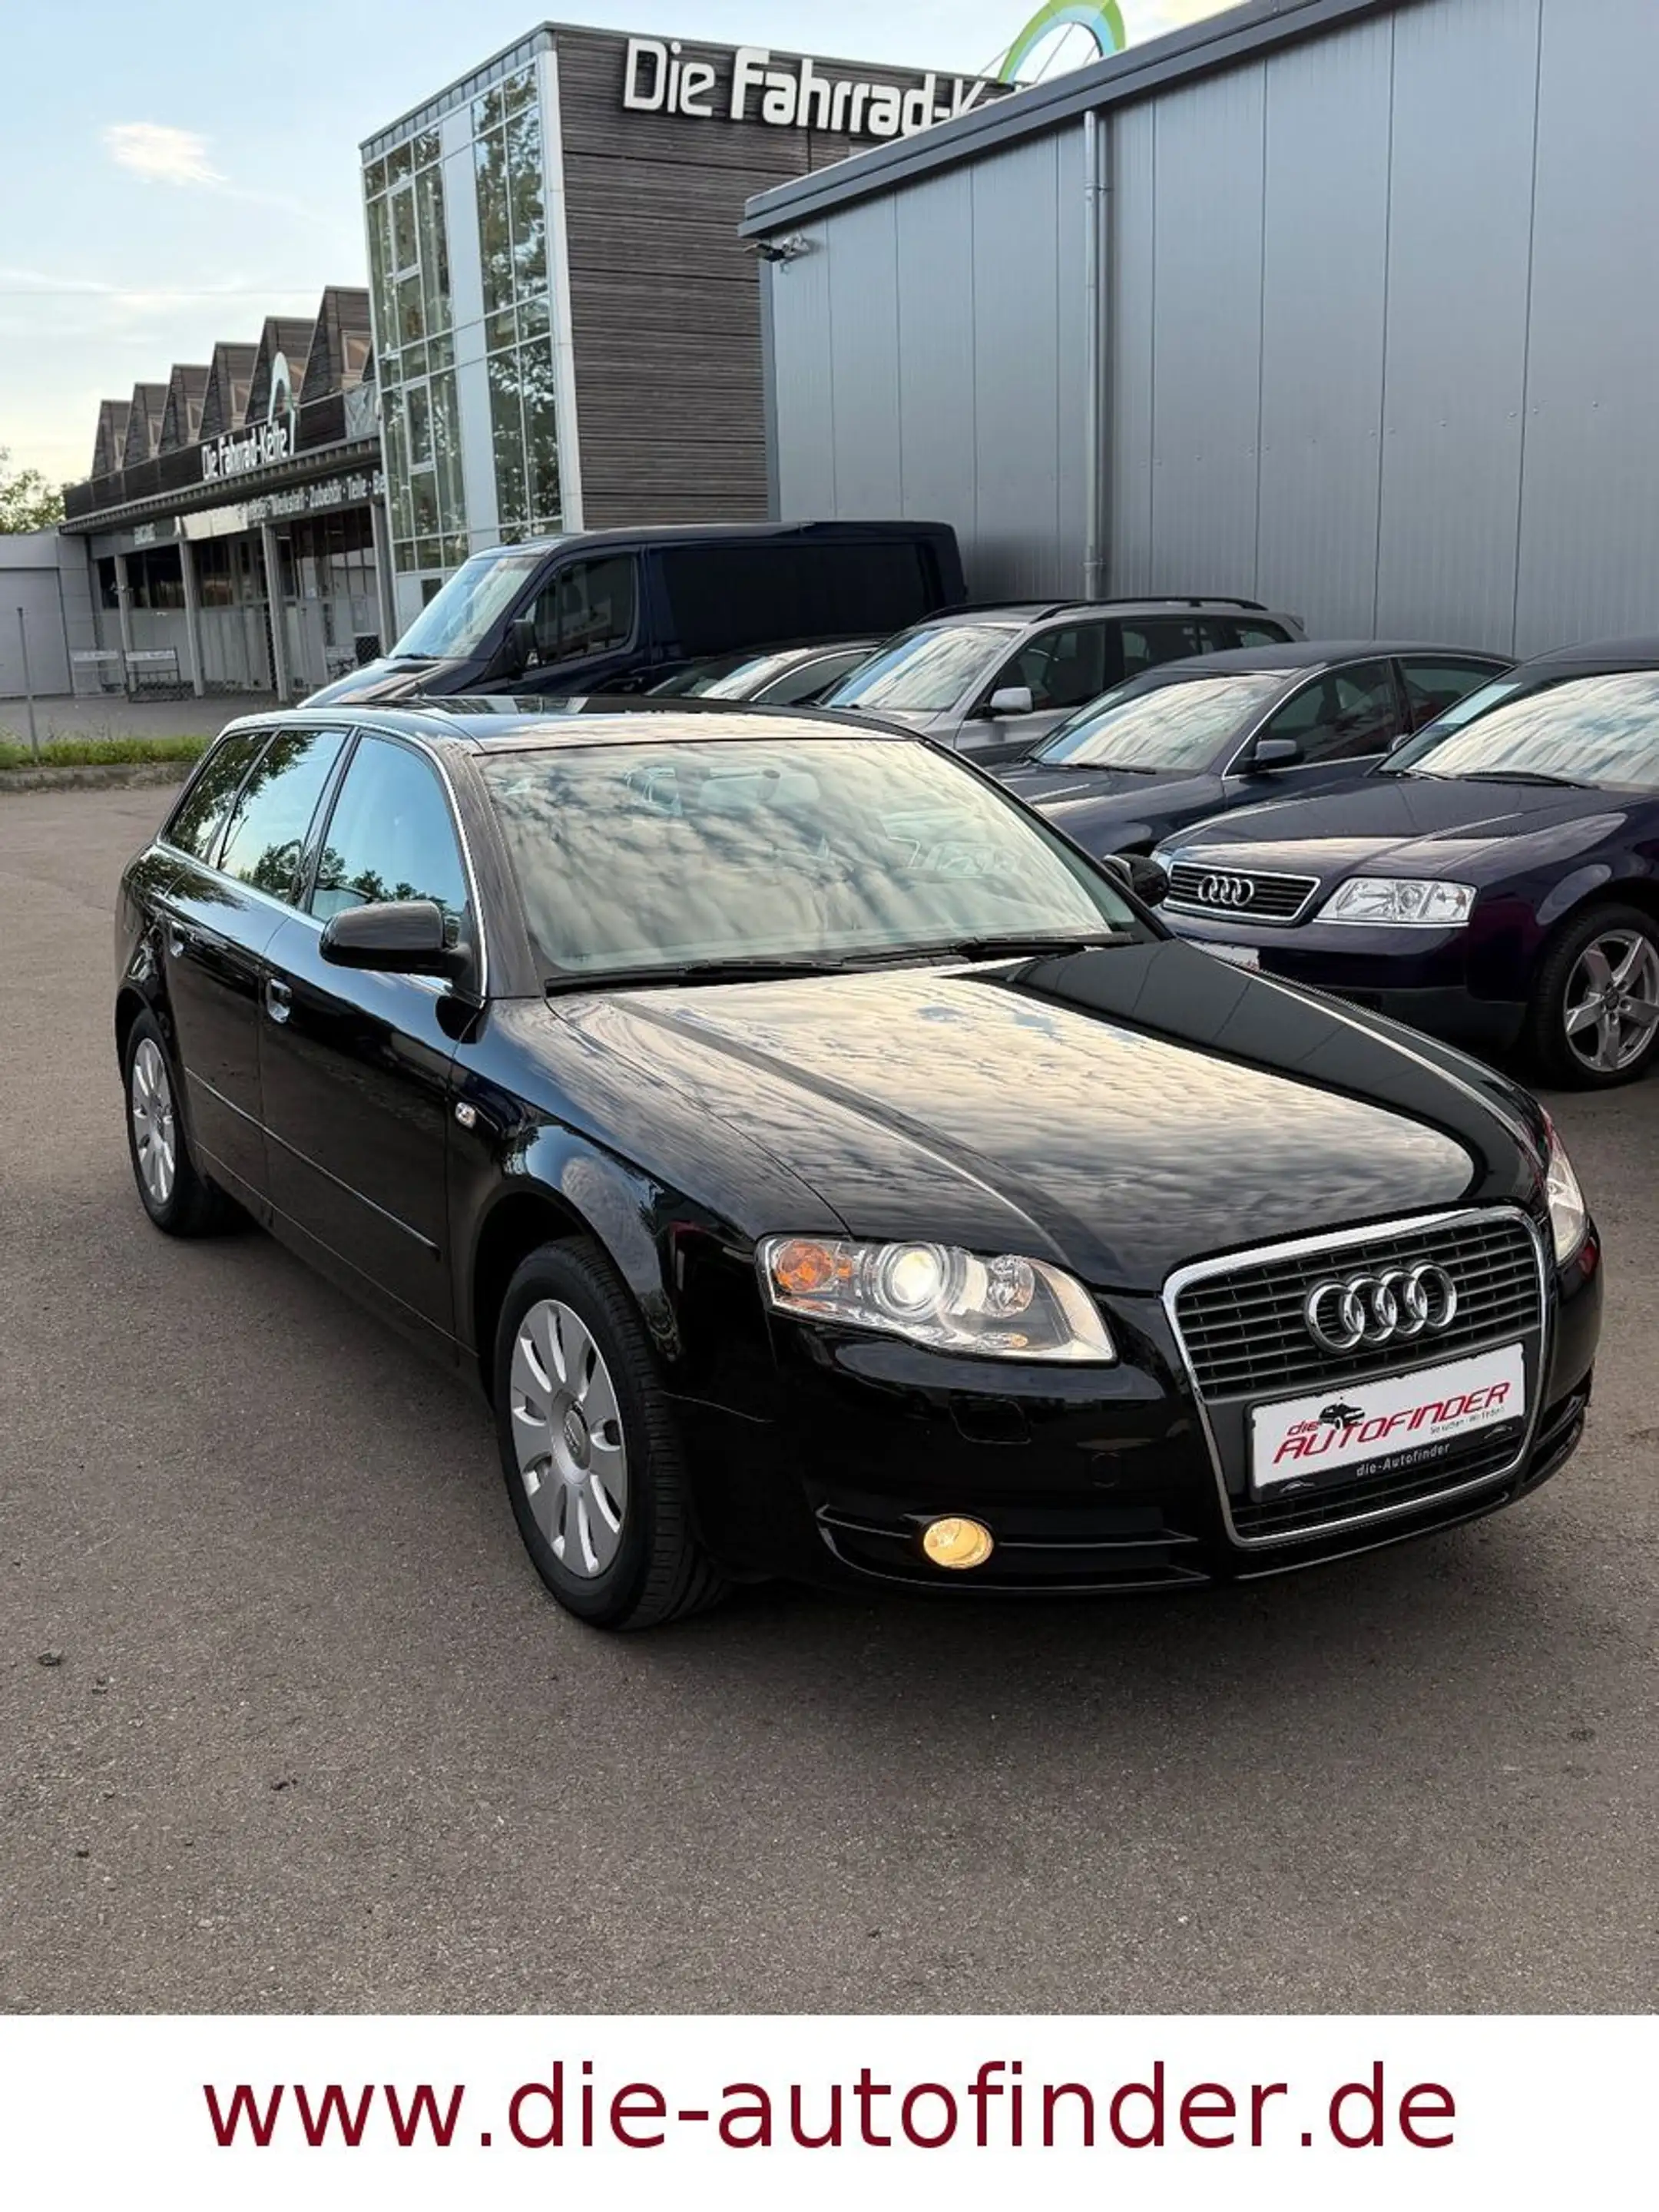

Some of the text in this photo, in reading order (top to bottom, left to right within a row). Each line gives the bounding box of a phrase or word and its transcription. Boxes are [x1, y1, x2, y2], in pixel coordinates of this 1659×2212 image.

[623, 38, 1022, 137] Die Fahrrad-K
[201, 444, 218, 480] Die
[1273, 1382, 1510, 1464] AUTOFINDER
[1287, 1419, 1321, 1436] die
[1356, 1443, 1450, 1477] die-Autofinder
